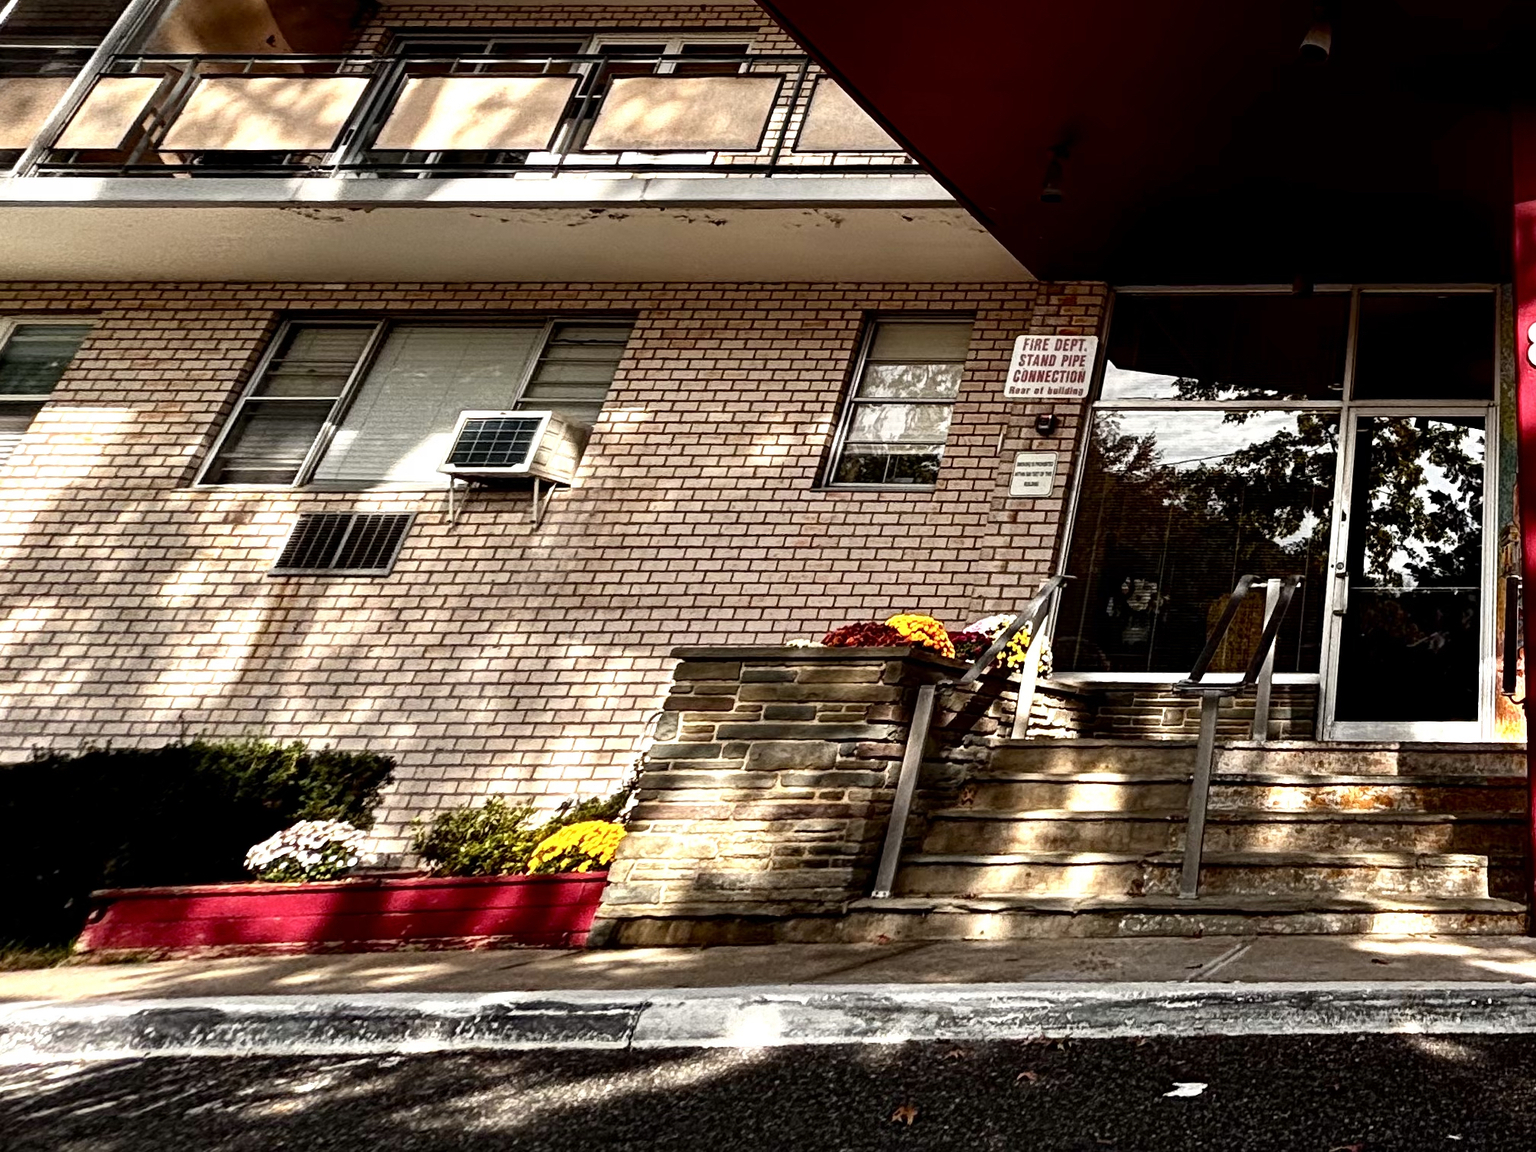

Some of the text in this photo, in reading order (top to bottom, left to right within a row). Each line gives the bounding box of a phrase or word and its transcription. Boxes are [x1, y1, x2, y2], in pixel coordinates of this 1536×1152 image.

[1022, 338, 1088, 352] FIRE DEPT.
[1018, 354, 1087, 367] STAND PIPE
[1013, 369, 1086, 383] CONNECTION
[1008, 386, 1084, 396] Rear of building
